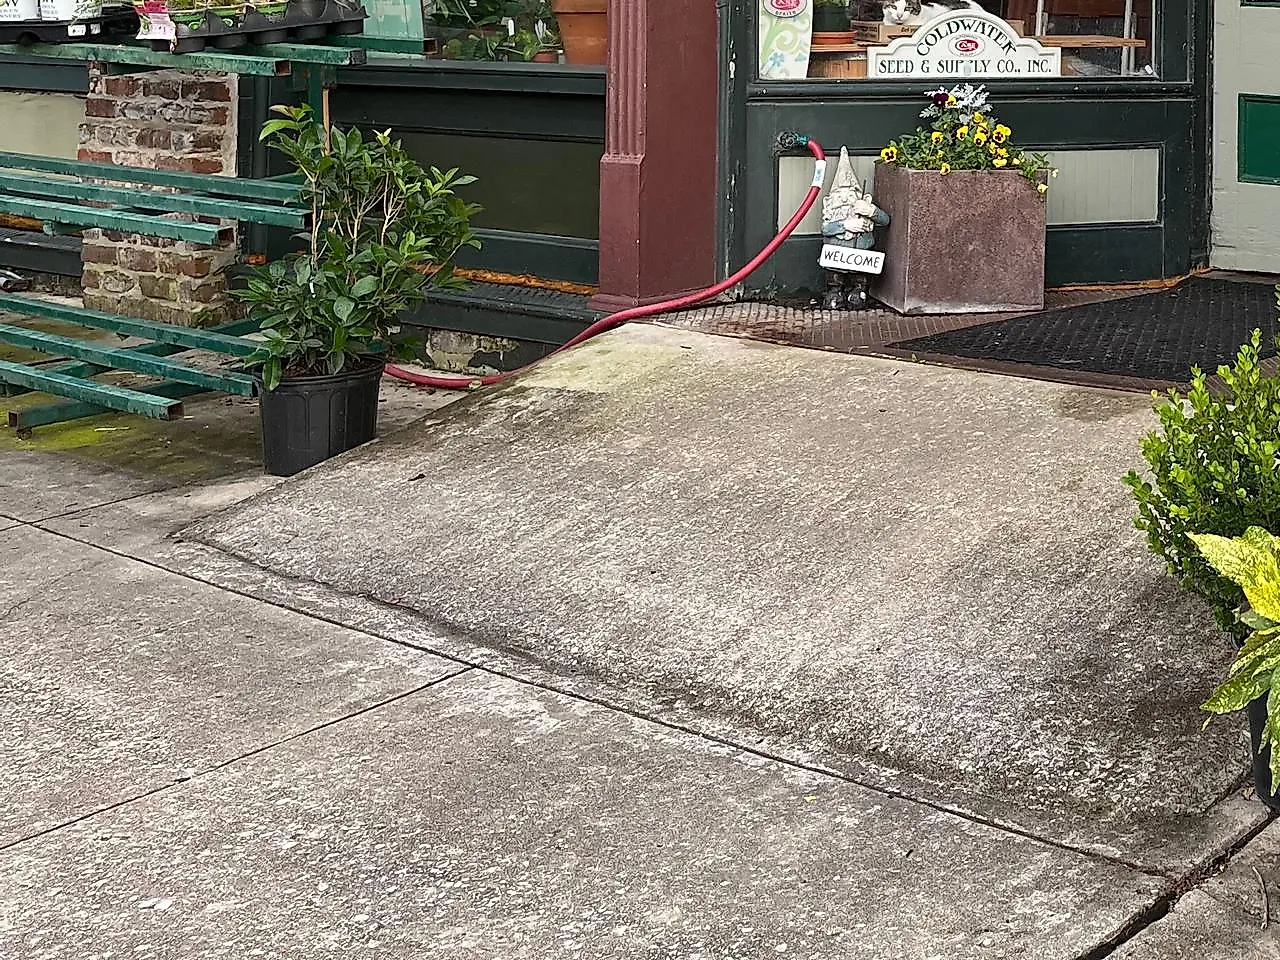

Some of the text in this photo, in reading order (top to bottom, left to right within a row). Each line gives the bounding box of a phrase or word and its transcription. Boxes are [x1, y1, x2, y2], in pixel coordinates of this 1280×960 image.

[916, 19, 1018, 57] COLDWATER
[878, 59, 915, 74] SEED
[920, 60, 930, 74] &
[1027, 59, 1052, 74] INC.
[824, 250, 881, 269] WELCOME
